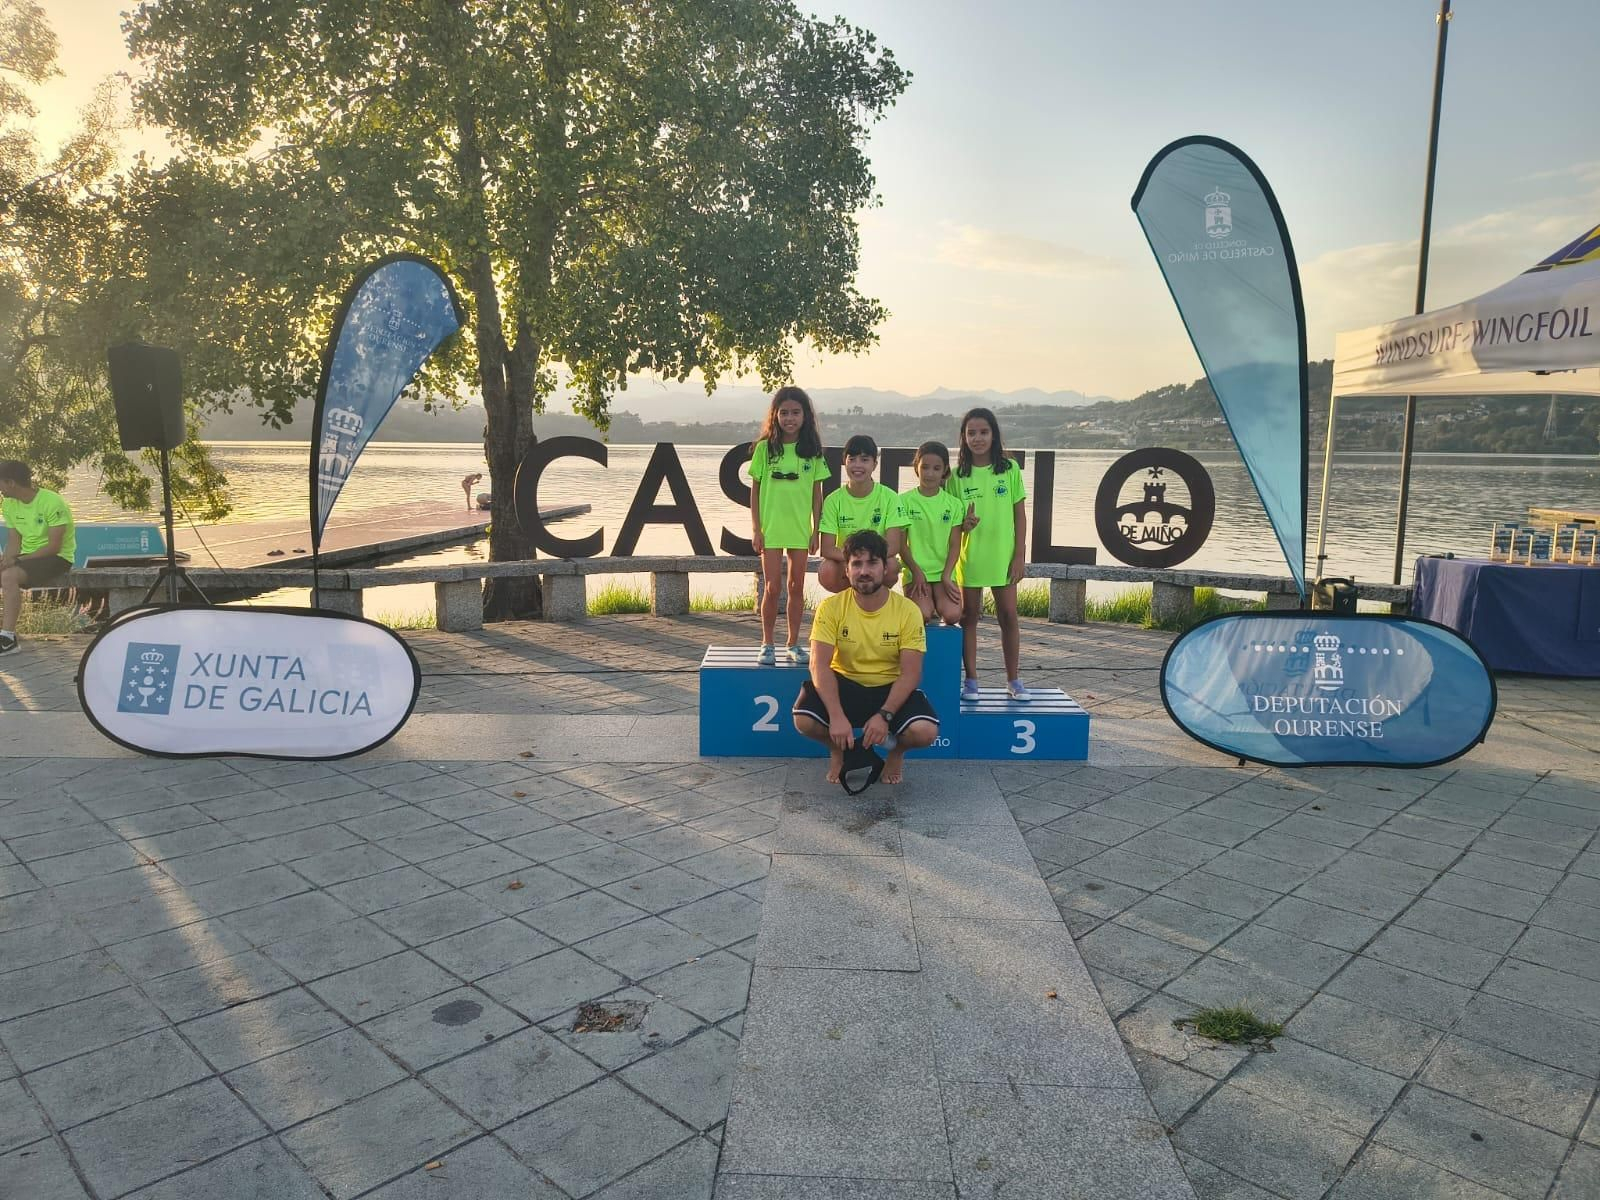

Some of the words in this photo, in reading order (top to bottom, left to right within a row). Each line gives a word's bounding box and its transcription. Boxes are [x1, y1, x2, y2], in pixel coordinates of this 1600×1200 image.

[1120, 525, 1138, 539] DE
[1142, 524, 1183, 541] MIÑO
[190, 652, 306, 681] XUNTA
[184, 684, 228, 710] DE
[239, 686, 373, 717] GALICIA
[751, 695, 780, 732] 2
[1254, 695, 1401, 717] DEPUTACIÓN
[1010, 719, 1037, 755] 3
[1274, 718, 1384, 739] OURENSE
